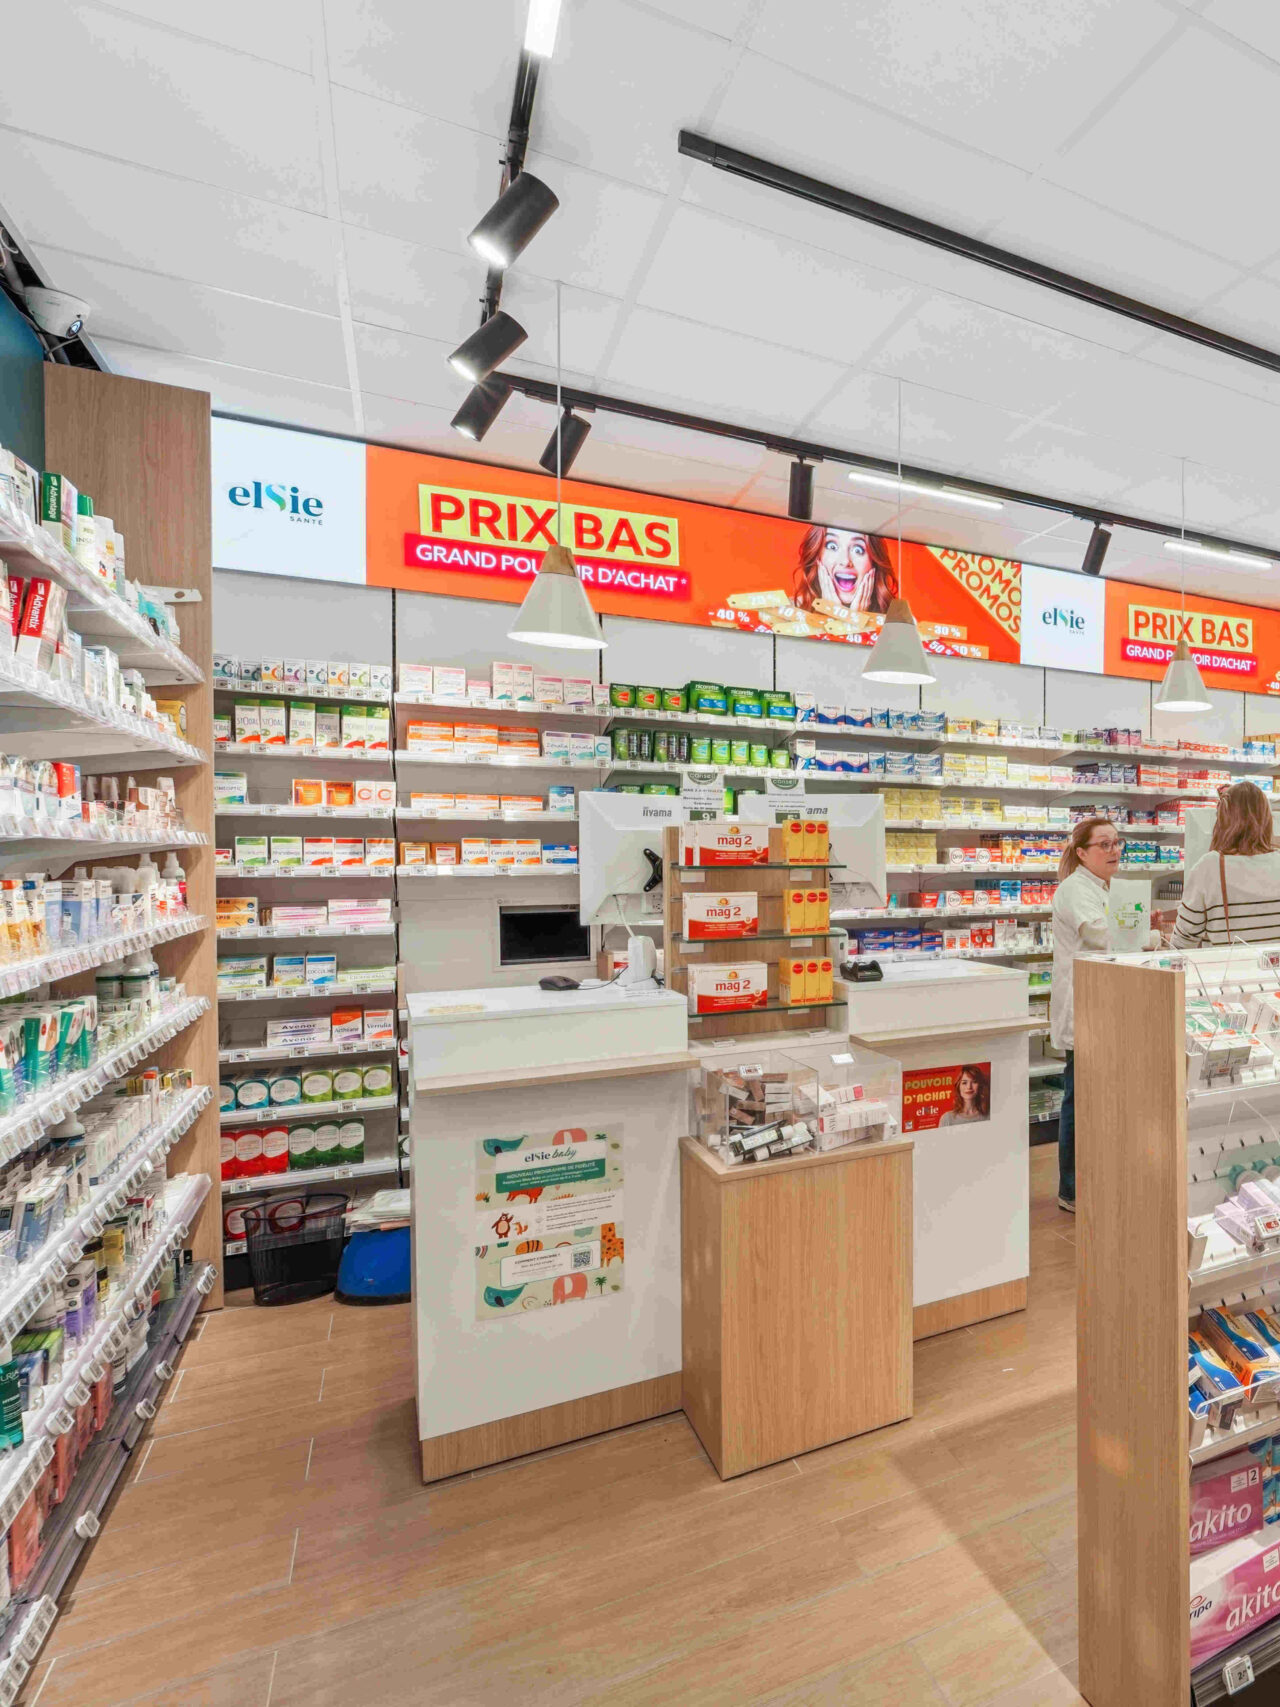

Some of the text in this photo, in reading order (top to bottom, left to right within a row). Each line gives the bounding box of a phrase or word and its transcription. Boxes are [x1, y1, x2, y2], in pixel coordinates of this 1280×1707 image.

[430, 493, 672, 558] PRIX BAS
[416, 544, 677, 591] GRAND POUIR D'ACHAT
[1134, 611, 1249, 648] PRIX BAS
[1126, 645, 1252, 671] GRAND POIR D'ACHAT
[717, 836, 752, 847] mag 2
[706, 906, 741, 919] mag 2
[715, 980, 750, 992] mag 2
[905, 1077, 952, 1090] POUVOIR
[904, 1091, 952, 1104] D'ACHAT
[1250, 1470, 1257, 1481] 2
[1190, 1503, 1252, 1542] akito
